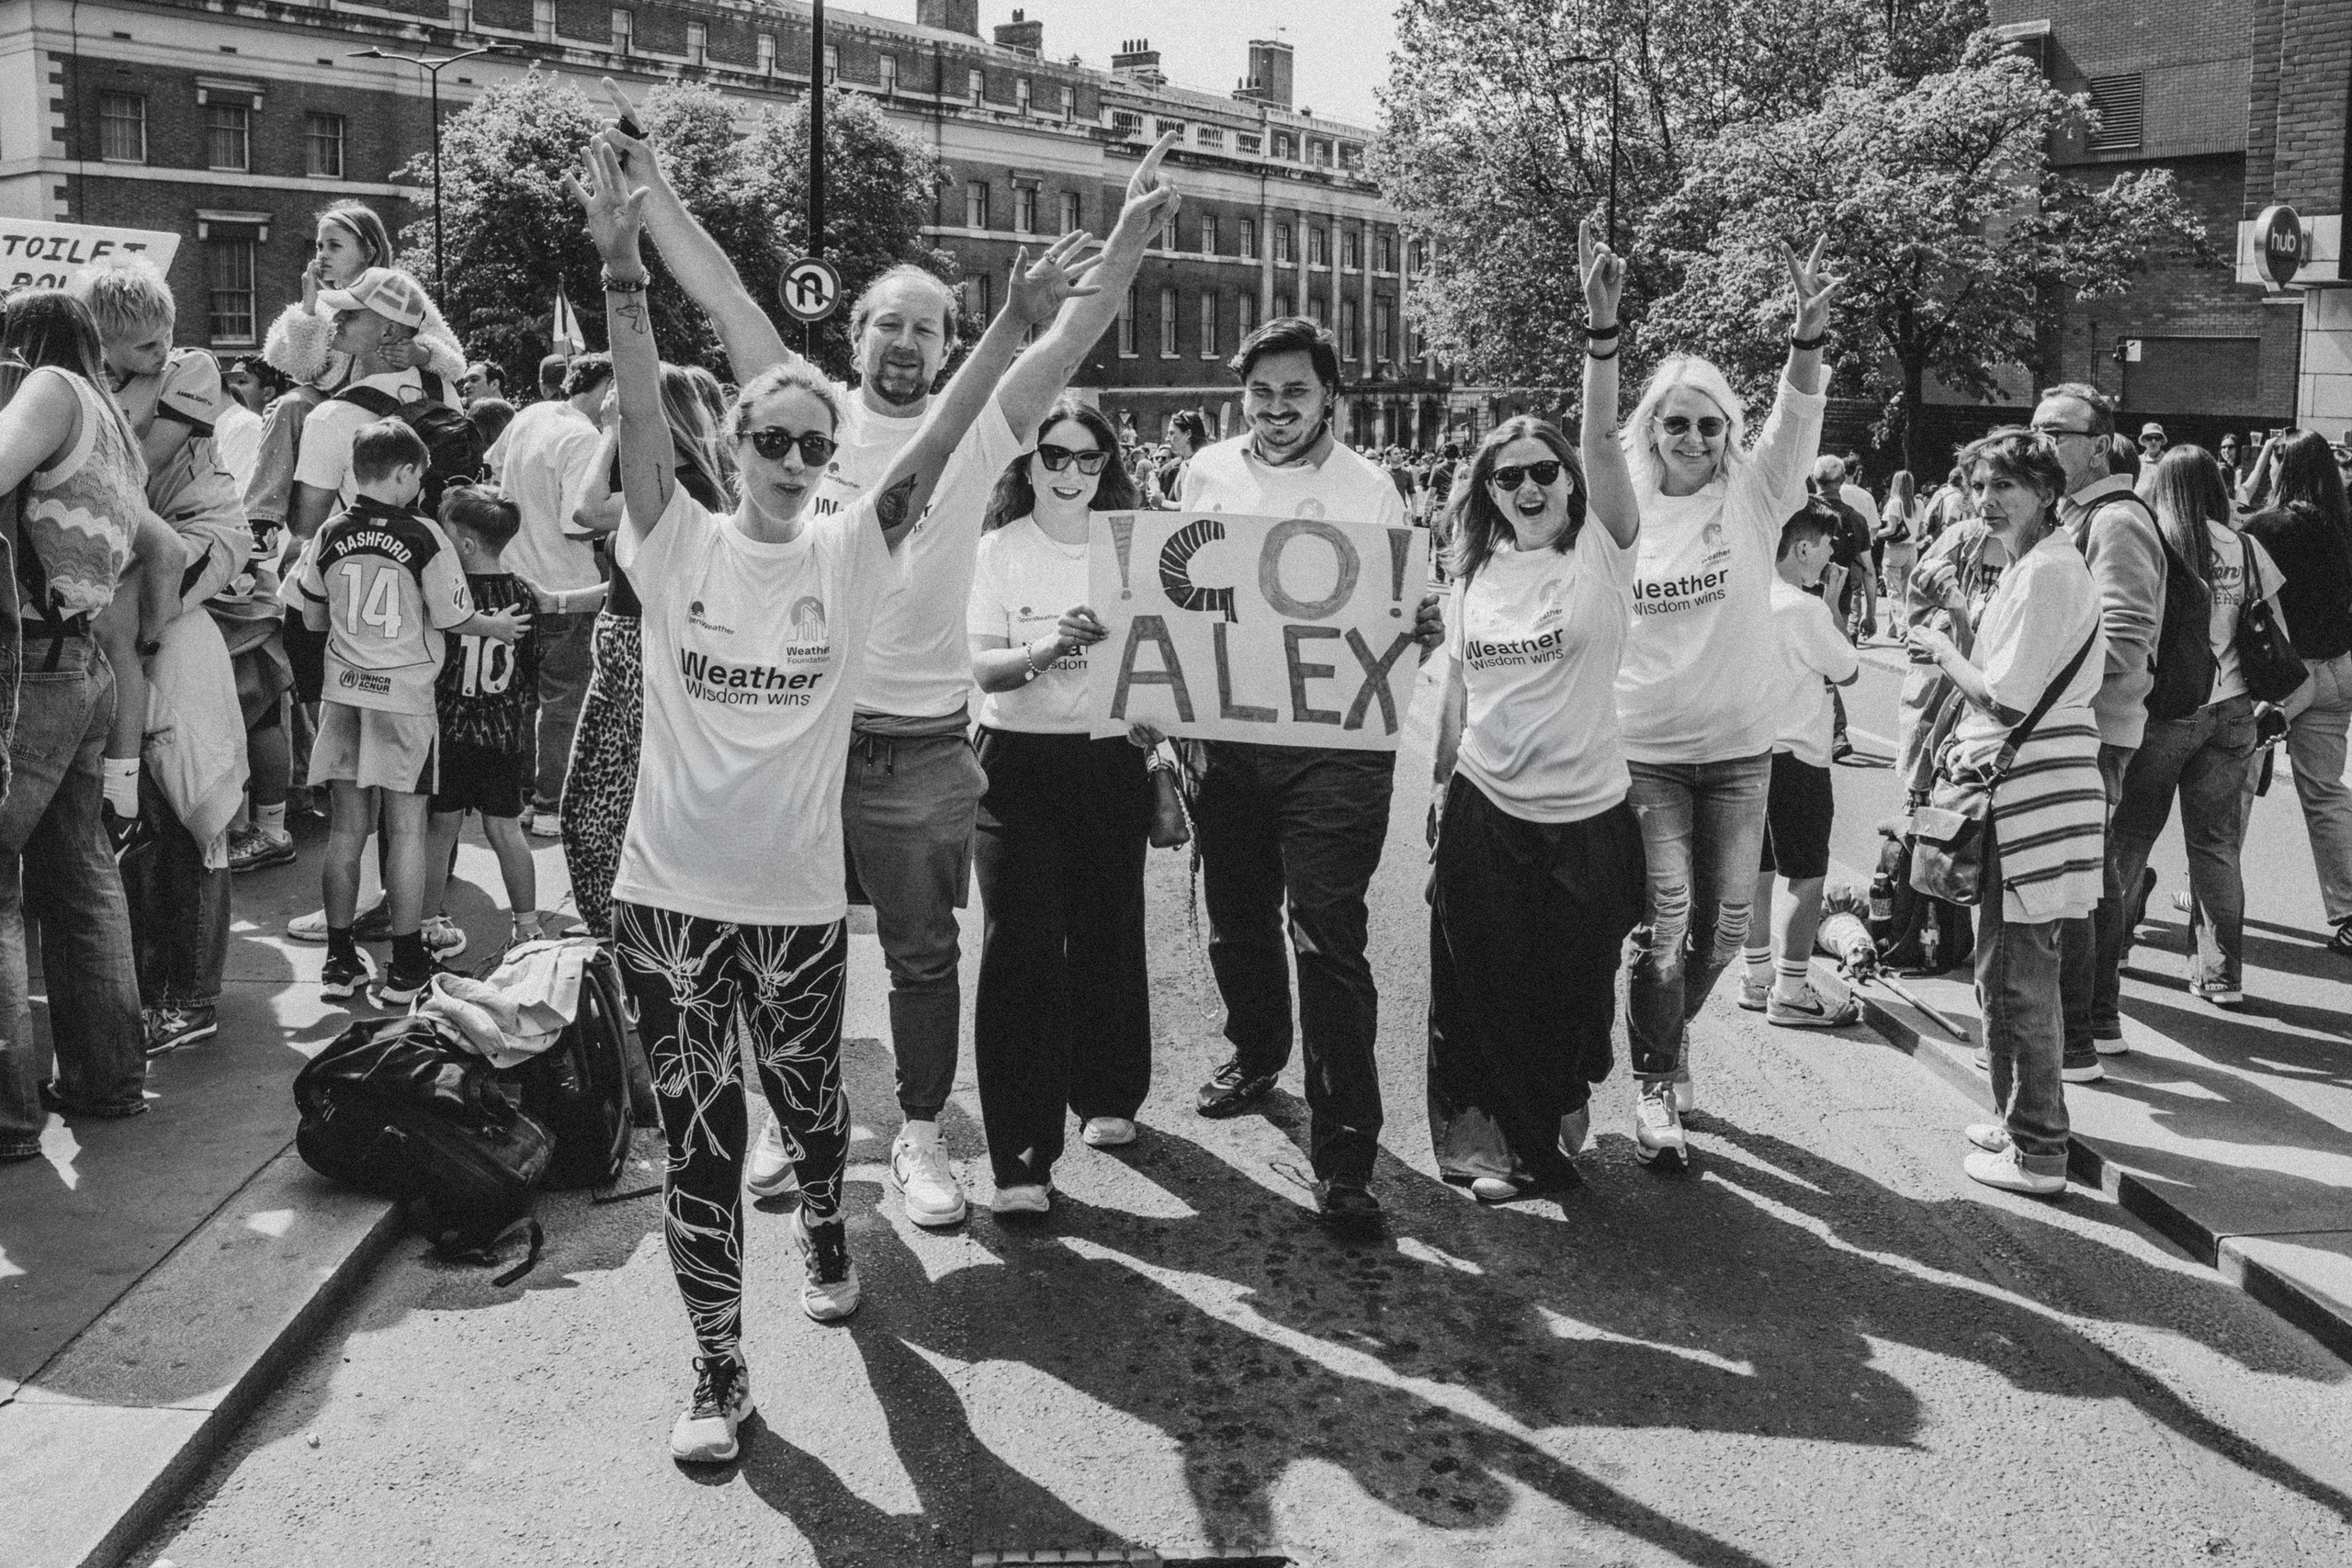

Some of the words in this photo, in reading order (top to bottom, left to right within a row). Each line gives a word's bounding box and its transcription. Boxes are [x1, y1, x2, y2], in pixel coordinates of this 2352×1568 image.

[2271, 226, 2296, 253] hub
[334, 531, 412, 564] RASHFORD
[1701, 548, 1731, 564] eather
[339, 562, 403, 639] 14
[1633, 600, 1690, 615] Wisdom
[1694, 589, 1725, 606] wins
[689, 616, 735, 635] penWeather
[1465, 628, 1564, 660] Weather
[459, 635, 515, 697] 10
[681, 648, 823, 690] Weather
[1050, 660, 1088, 670] sdom
[1470, 656, 1526, 671] Wisdom
[1530, 648, 1564, 664] wins
[358, 682, 390, 692] ACNUR
[360, 673, 391, 684] UNHCR
[1109, 615, 1417, 736] ALEX
[686, 679, 758, 705] Wisdom
[767, 693, 811, 706] wins
